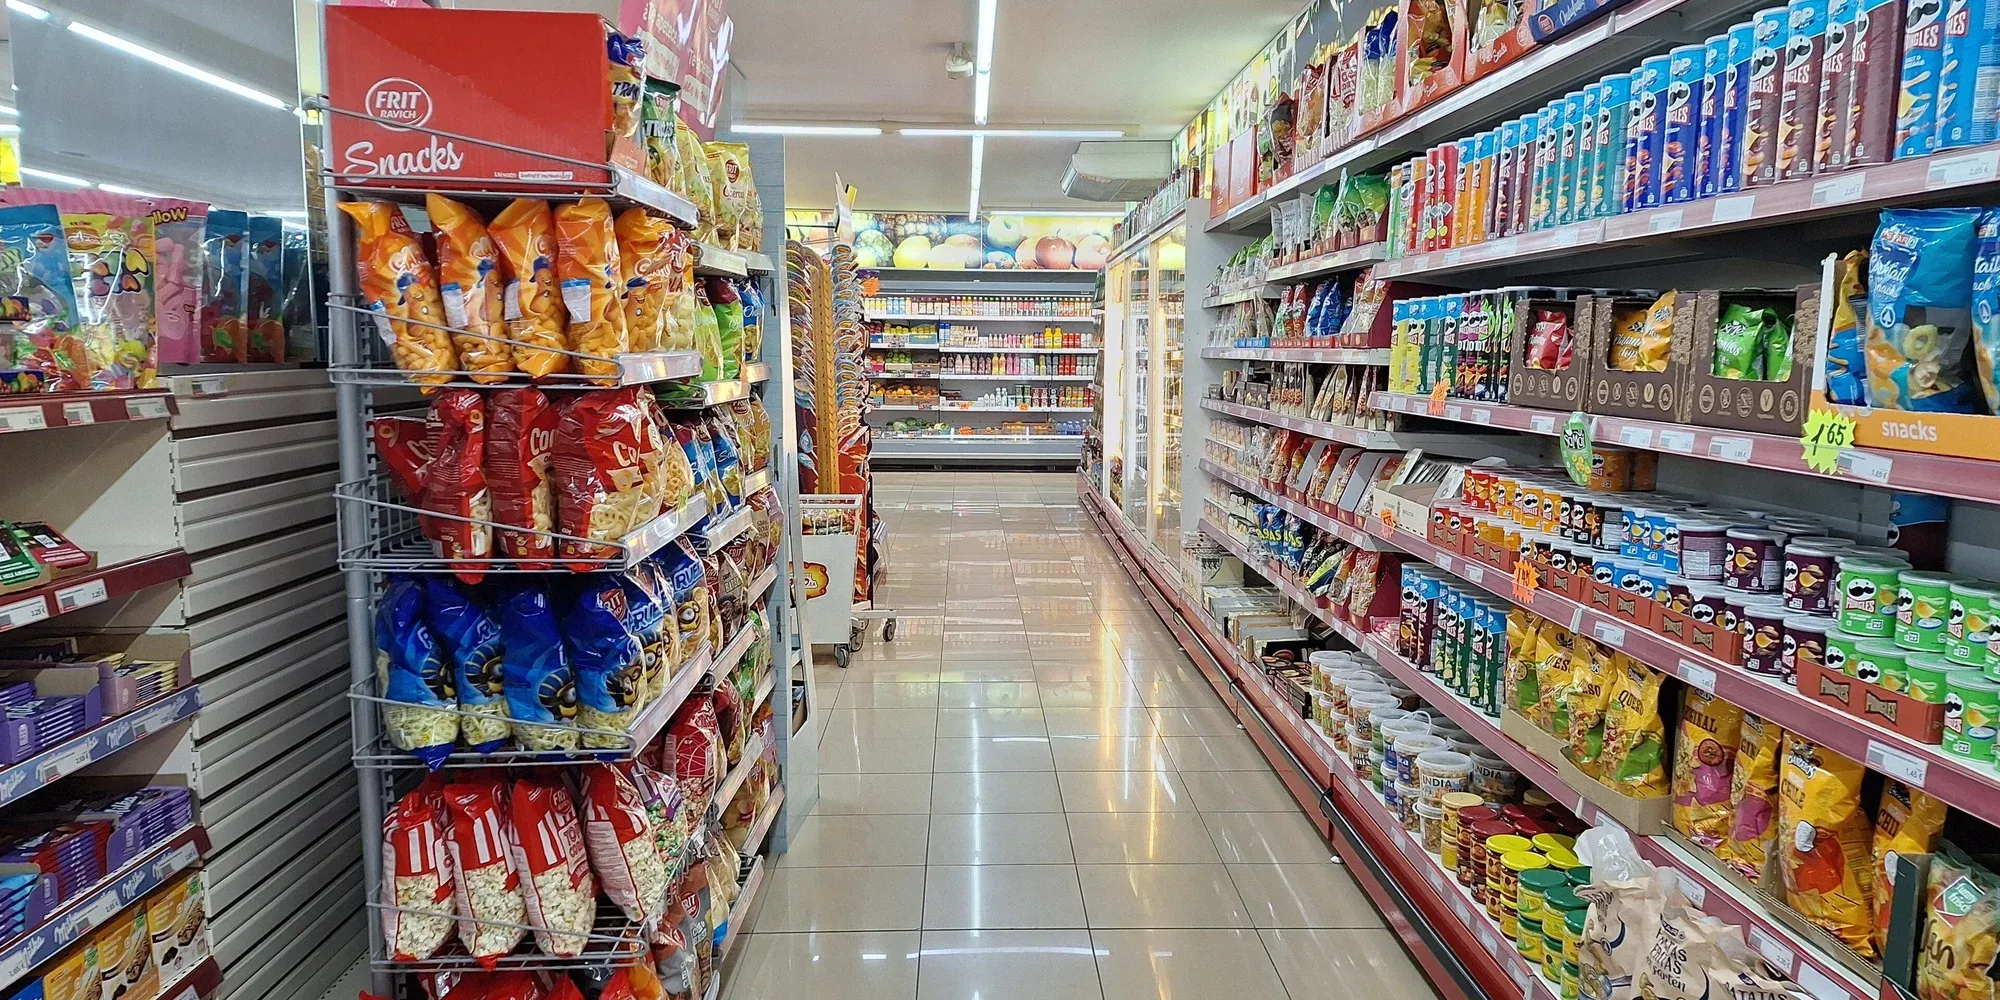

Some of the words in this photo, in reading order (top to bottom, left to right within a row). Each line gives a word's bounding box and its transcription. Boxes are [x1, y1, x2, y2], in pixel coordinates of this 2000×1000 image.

[375, 91, 422, 109] FRIT
[380, 109, 417, 119] RAVICH
[343, 135, 464, 183] Snacks
[1881, 420, 1938, 442] snacks
[1618, 690, 1644, 715] QUESO
[1422, 774, 1453, 789] INDIA
[1475, 765, 1502, 780] NDIA
